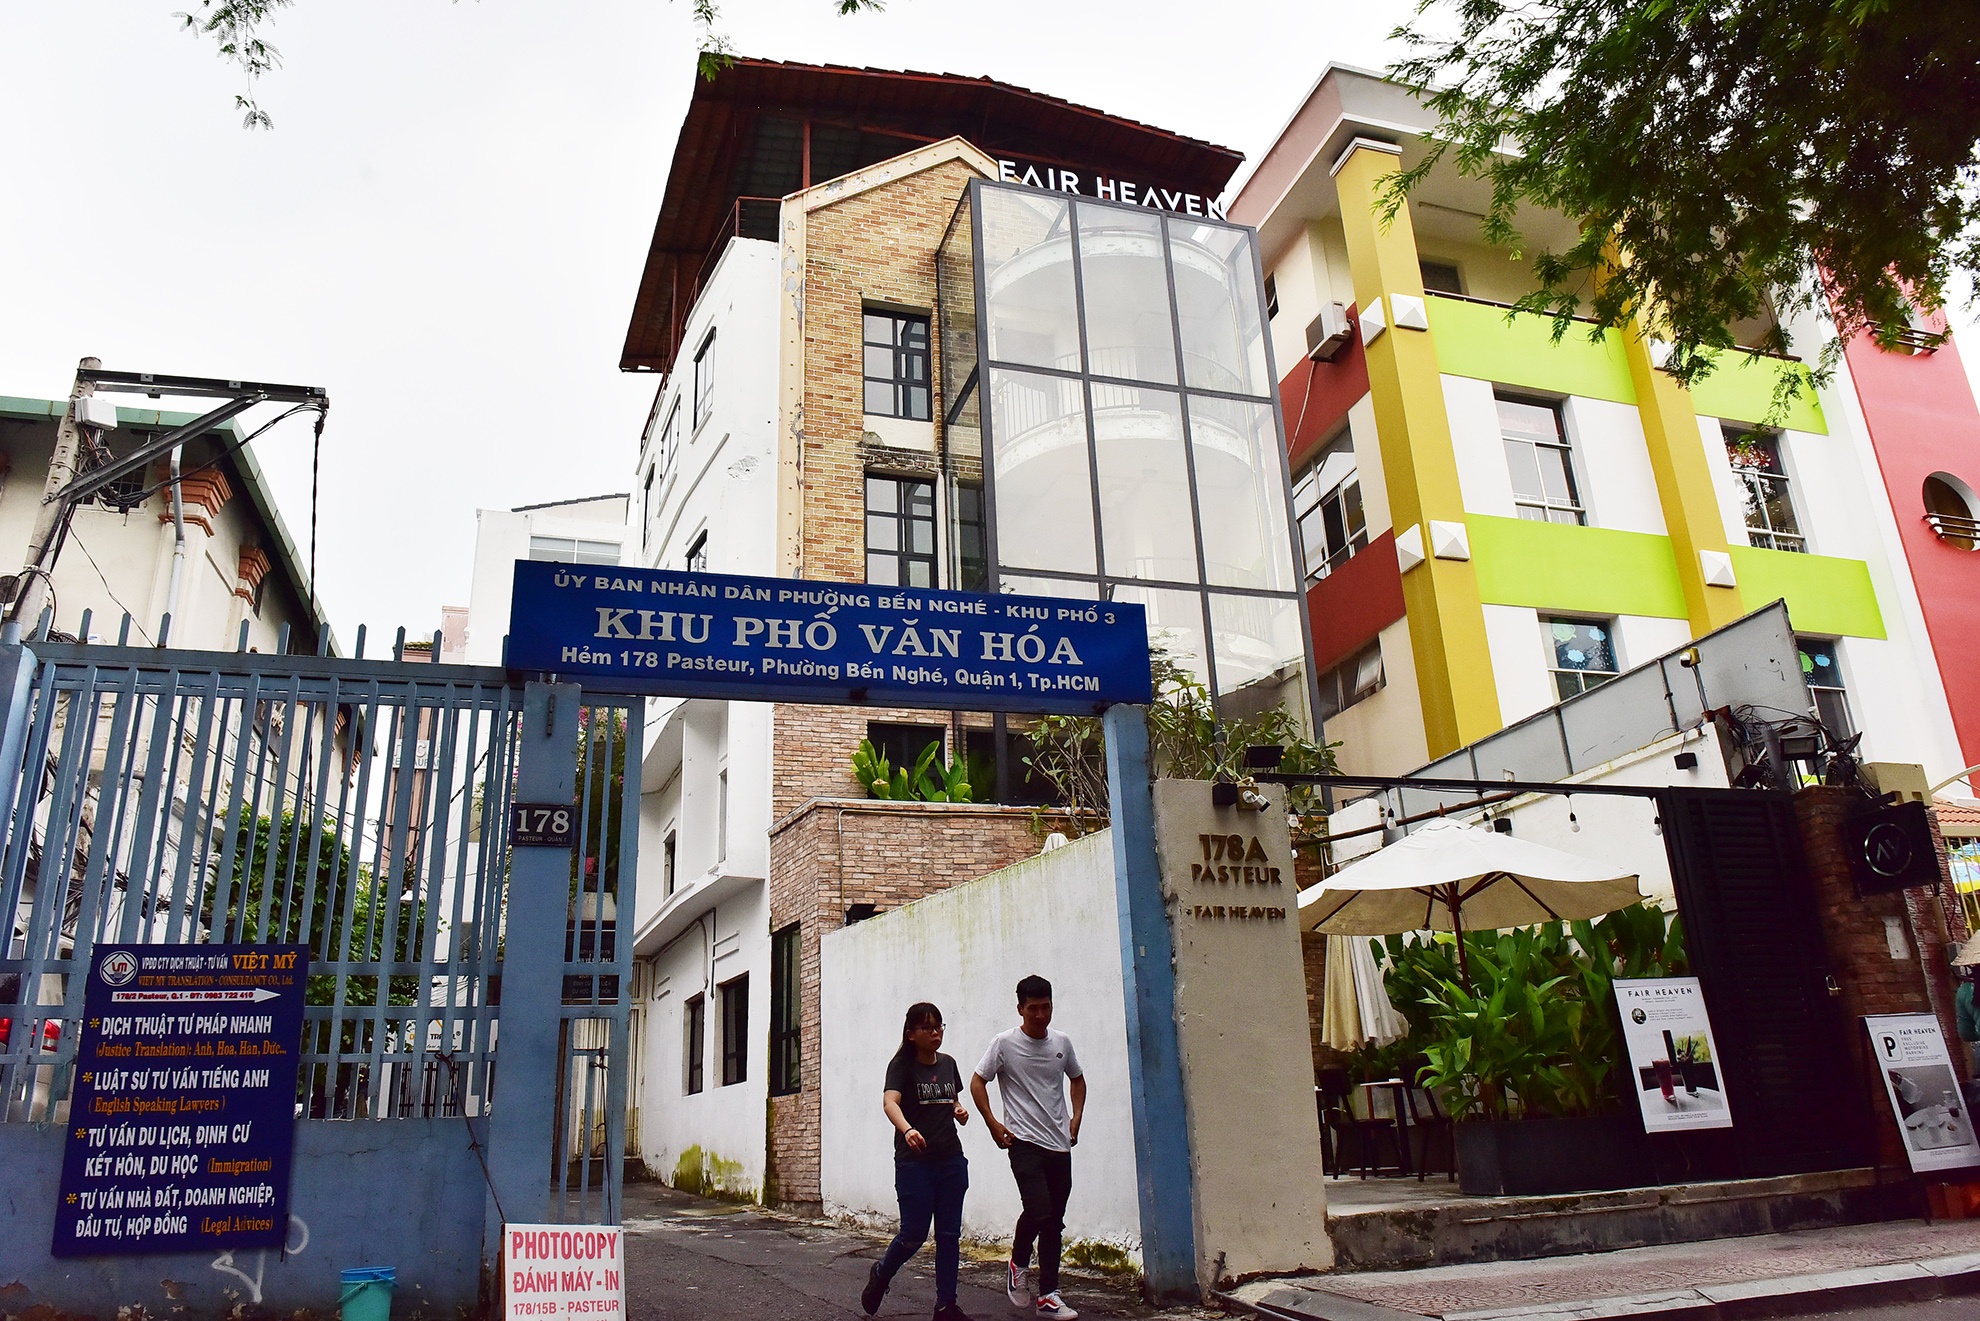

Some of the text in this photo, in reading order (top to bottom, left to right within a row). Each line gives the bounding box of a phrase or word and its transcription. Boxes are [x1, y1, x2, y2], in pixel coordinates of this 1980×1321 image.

[999, 160, 1227, 221] FAIR HEAVEN
[554, 569, 587, 588] ỦY
[595, 575, 643, 592] BAN
[651, 580, 716, 598] NHÂN
[725, 585, 770, 601] DÂN
[779, 588, 870, 607] PHƯỜNG
[878, 592, 921, 610] BẾN
[929, 596, 987, 615] NGHÉ
[1006, 605, 1049, 620] KHU
[1058, 605, 1098, 623] PHỐ
[1105, 612, 1115, 624] 3
[594, 605, 1083, 665] KHU PHỐ VĂN HÓA
[562, 646, 1099, 691] Hẻm 178 Pasteur, Phường Bến Nghé, Quận 1, Tp.HCM
[517, 810, 569, 834] 178
[1199, 834, 1268, 861] 178A
[1191, 864, 1282, 884] PASTEUR
[1194, 906, 1286, 919] FAIR HEAVEN
[232, 951, 270, 972] VIỆT
[272, 951, 298, 969] MỸ
[167, 975, 214, 986] TRANSLATION
[219, 975, 267, 986] CONSULTANCY
[102, 1013, 272, 1039] DỊCH THUẬT TƯ PHÁP NHANH
[1883, 1037, 1896, 1057] P
[94, 1064, 269, 1094] LUẬT SƯ TƯ VẤN TIẾNG ANH
[133, 1097, 176, 1115] Speaking
[89, 1121, 251, 1149] TƯ VẤN DU LỊCH, ĐỊNH CƯ
[85, 1151, 272, 1178] KẾT HÔN, DU HỌC (Immigration)
[80, 1183, 275, 1210] TƯ VẤN NHÀ ĐẤT, DOANH NGHIỆP,
[76, 1213, 101, 1237] ĐẦU
[105, 1216, 122, 1239] TƯ,
[126, 1215, 151, 1240] HỢP
[154, 1210, 187, 1235] ĐỒNG
[201, 1217, 231, 1235] (Legal
[513, 1232, 617, 1259] PHOTOCOPY
[513, 1266, 557, 1293] ĐÁNH
[562, 1266, 593, 1291] MÁY
[605, 1269, 619, 1290] IN
[514, 1302, 556, 1315] 178/15B
[568, 1300, 619, 1312] PASTEUR
